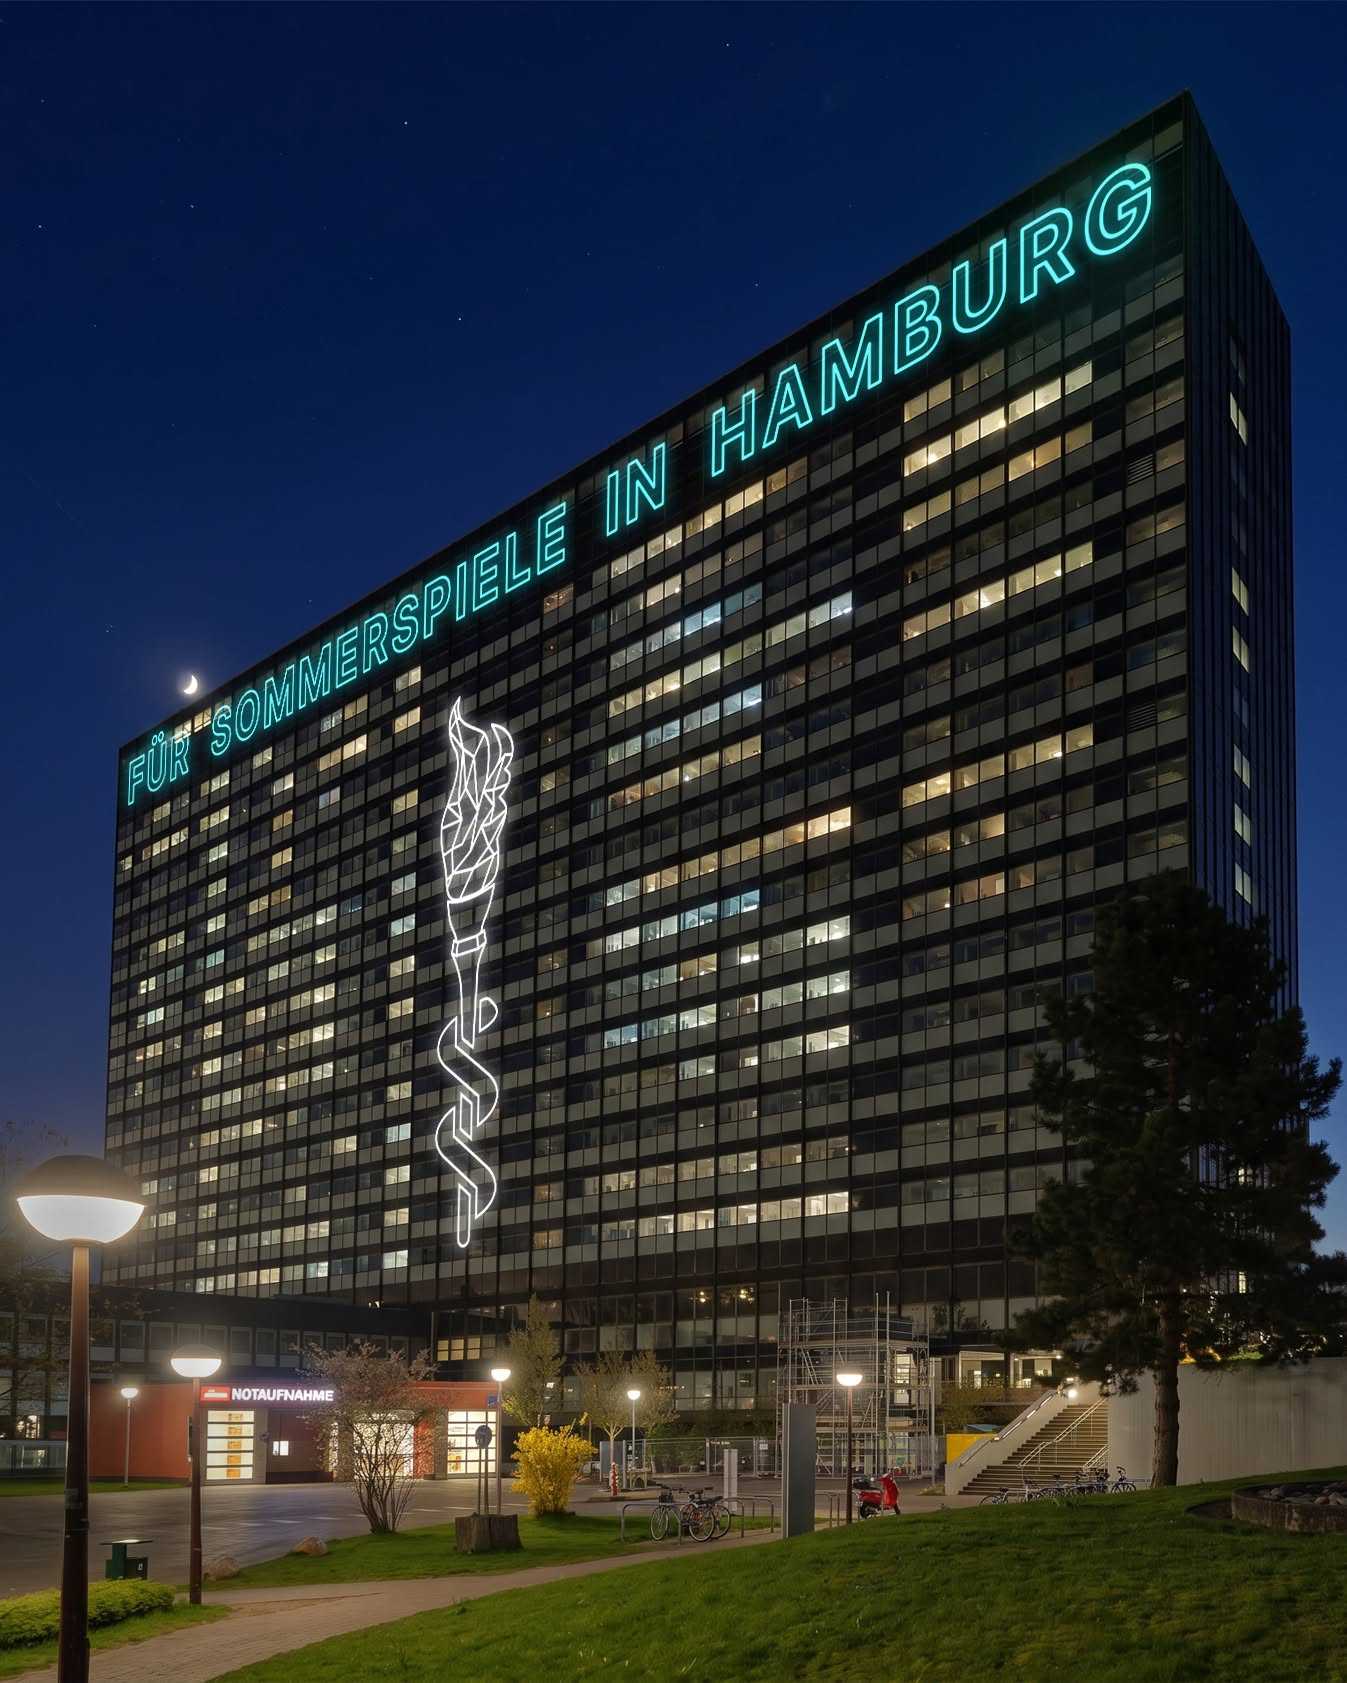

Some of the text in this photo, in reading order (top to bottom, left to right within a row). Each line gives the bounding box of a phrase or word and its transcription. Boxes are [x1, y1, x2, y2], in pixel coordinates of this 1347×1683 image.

[127, 162, 1152, 806] FÜR SOMMERSPIELE IN HAMBURG
[231, 1388, 334, 1402] NOTAUFNAHME
